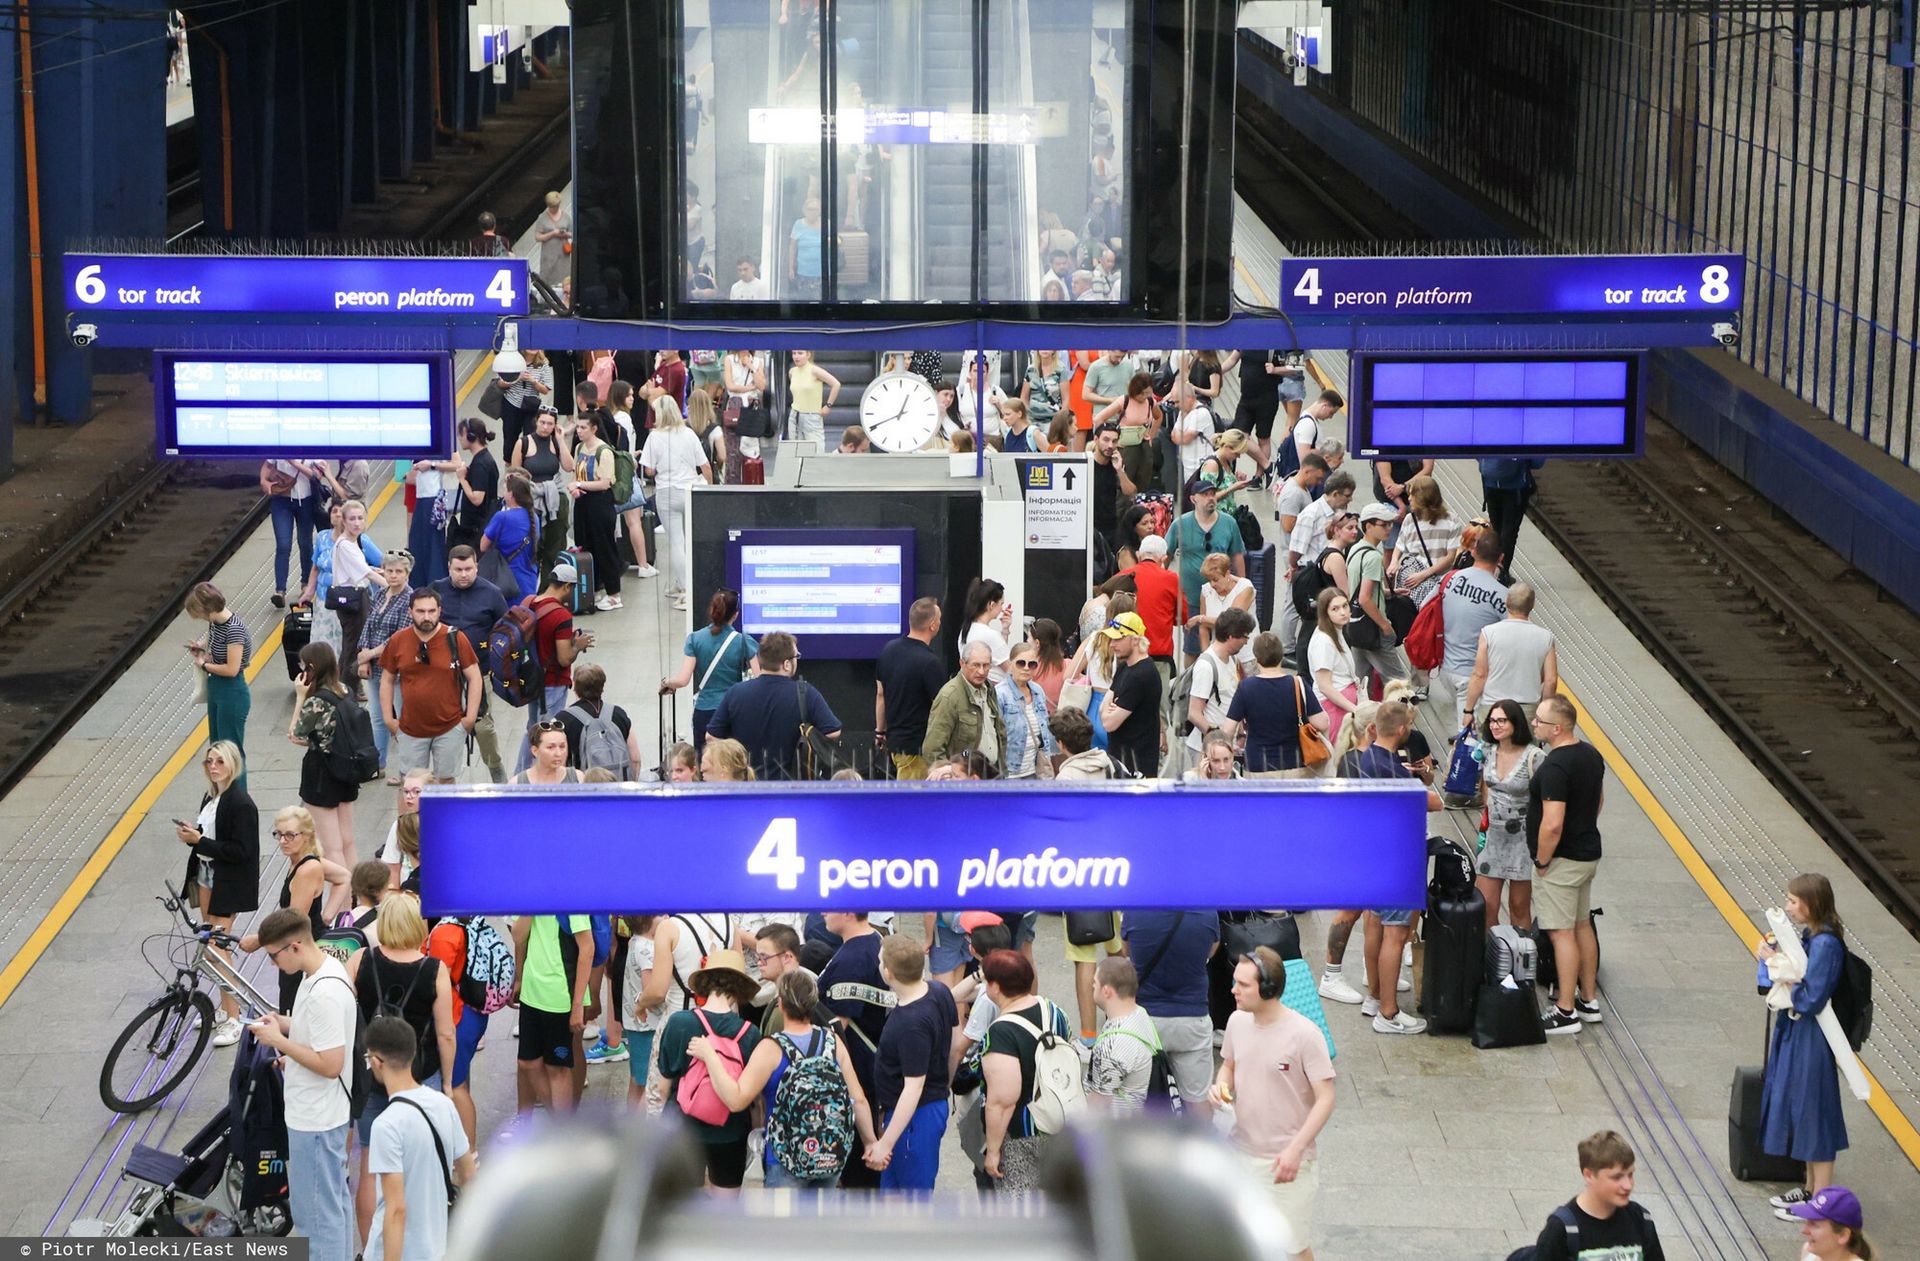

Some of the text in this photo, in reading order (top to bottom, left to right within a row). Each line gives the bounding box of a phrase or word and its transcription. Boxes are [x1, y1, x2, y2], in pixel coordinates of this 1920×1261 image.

[75, 265, 201, 304] 6 tor track
[334, 269, 516, 310] peron platform 4
[1293, 268, 1472, 309] 4 peron platform
[1604, 264, 1730, 304] tor track 8
[1028, 497, 1082, 505] Інформація
[1452, 576, 1507, 614] Angeles
[745, 817, 1132, 899] 4 peron platform
